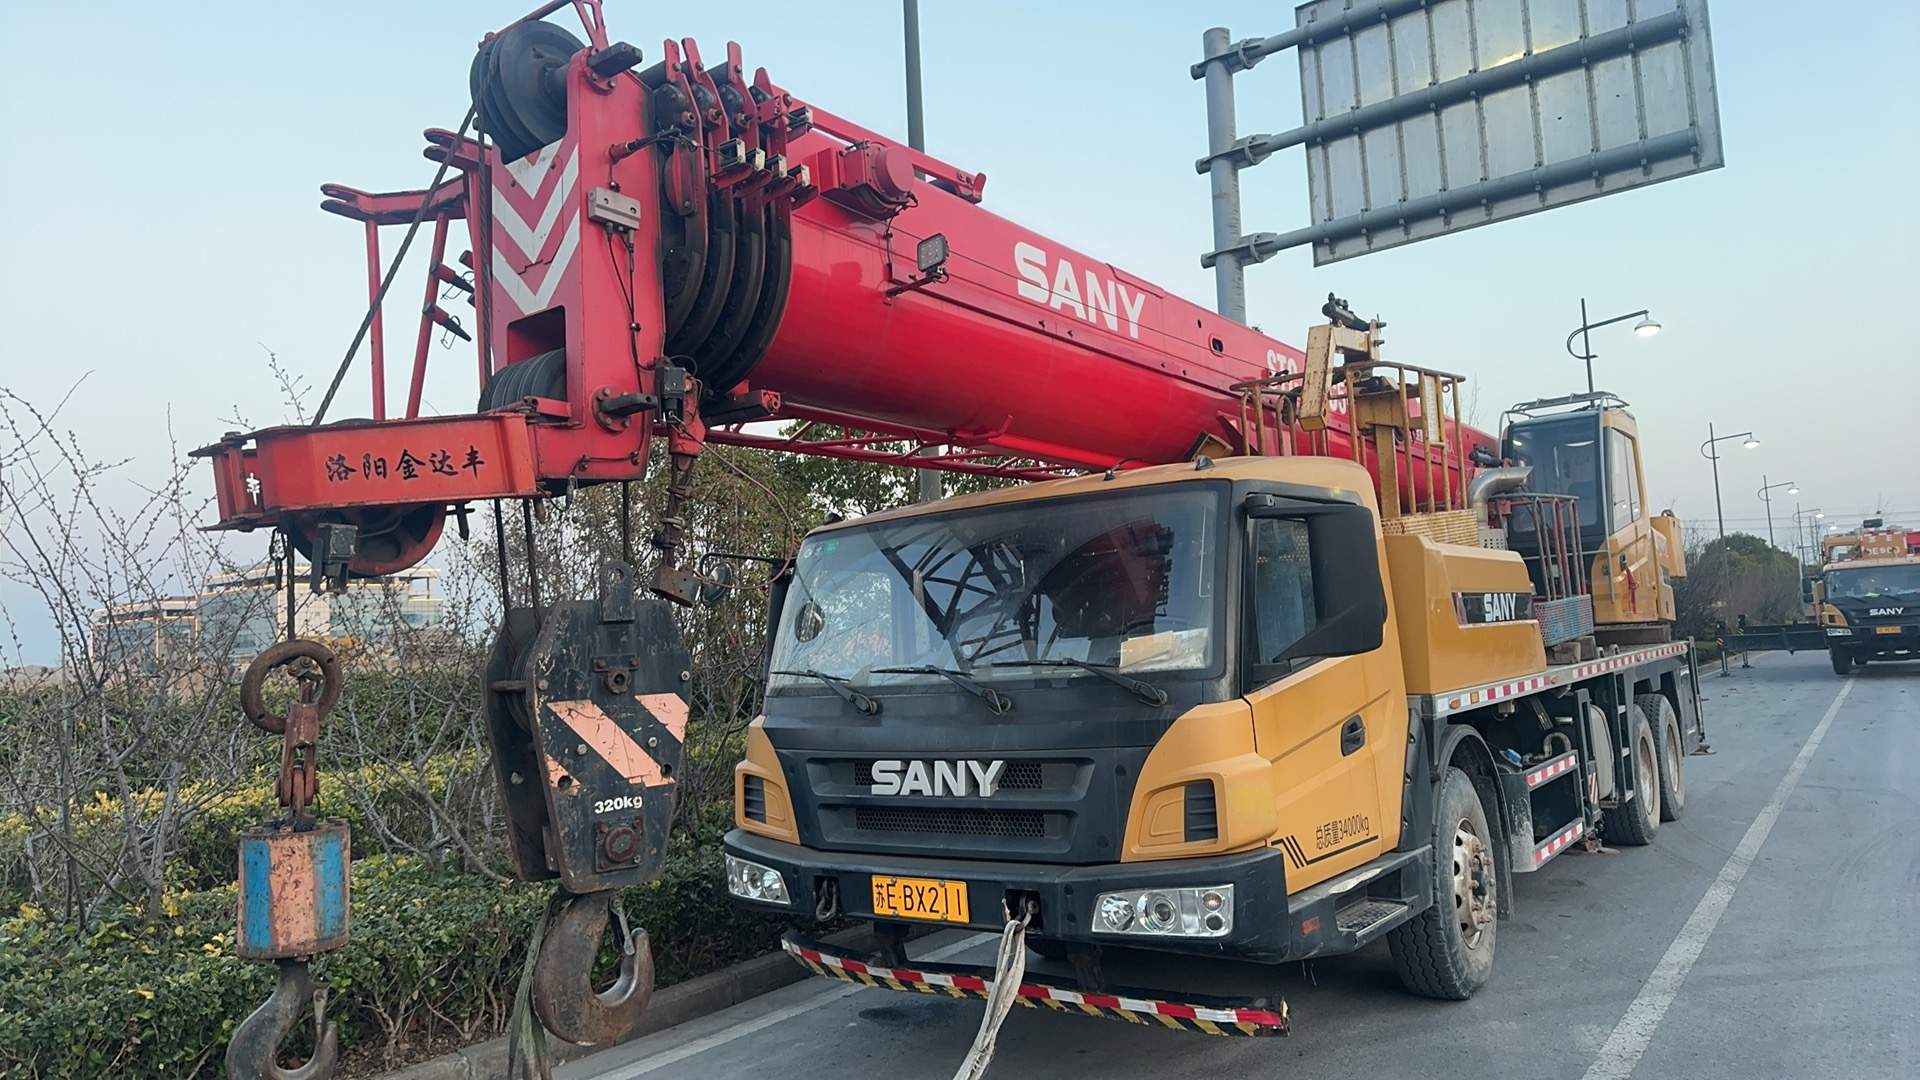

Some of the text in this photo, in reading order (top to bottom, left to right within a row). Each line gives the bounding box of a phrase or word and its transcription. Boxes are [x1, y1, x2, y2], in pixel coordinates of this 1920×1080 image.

[1014, 241, 1146, 340] SANY
[325, 445, 485, 482] 洛阳金达丰
[1483, 593, 1516, 622] SANY
[1869, 607, 1904, 616] SANY
[871, 760, 1004, 798] SANY
[594, 796, 643, 814] 320kg
[1315, 812, 1370, 850] 总质量34000kg
